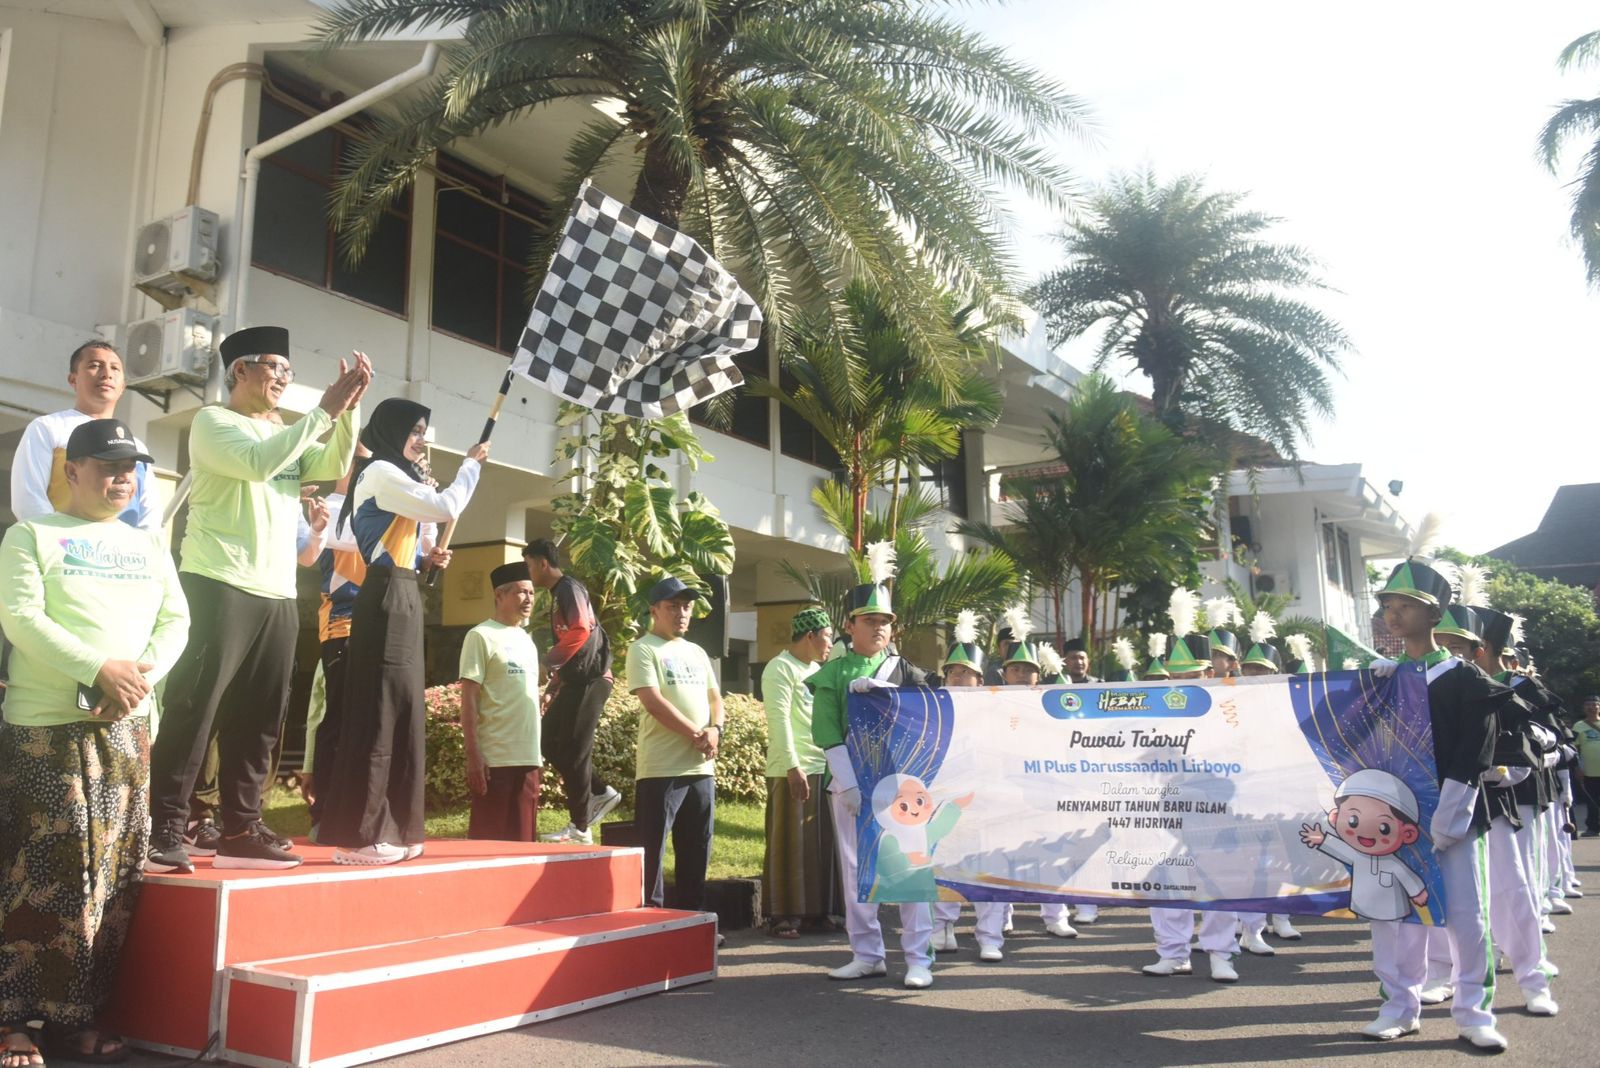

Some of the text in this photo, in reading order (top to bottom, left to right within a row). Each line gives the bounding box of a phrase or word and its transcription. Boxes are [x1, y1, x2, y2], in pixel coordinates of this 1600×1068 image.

[1098, 690, 1148, 711] HEBAT
[1070, 730, 1125, 749] Pawai
[1024, 759, 1241, 777] MI Plus Darussaadah Lirboyo
[1101, 782, 1181, 799] Dalam rangka
[1057, 801, 1227, 814] MENYAMBUT TAHUN BARU ISLAM
[1107, 817, 1183, 830] 1447 HIJRIYAH
[1106, 851, 1153, 869] Religius
